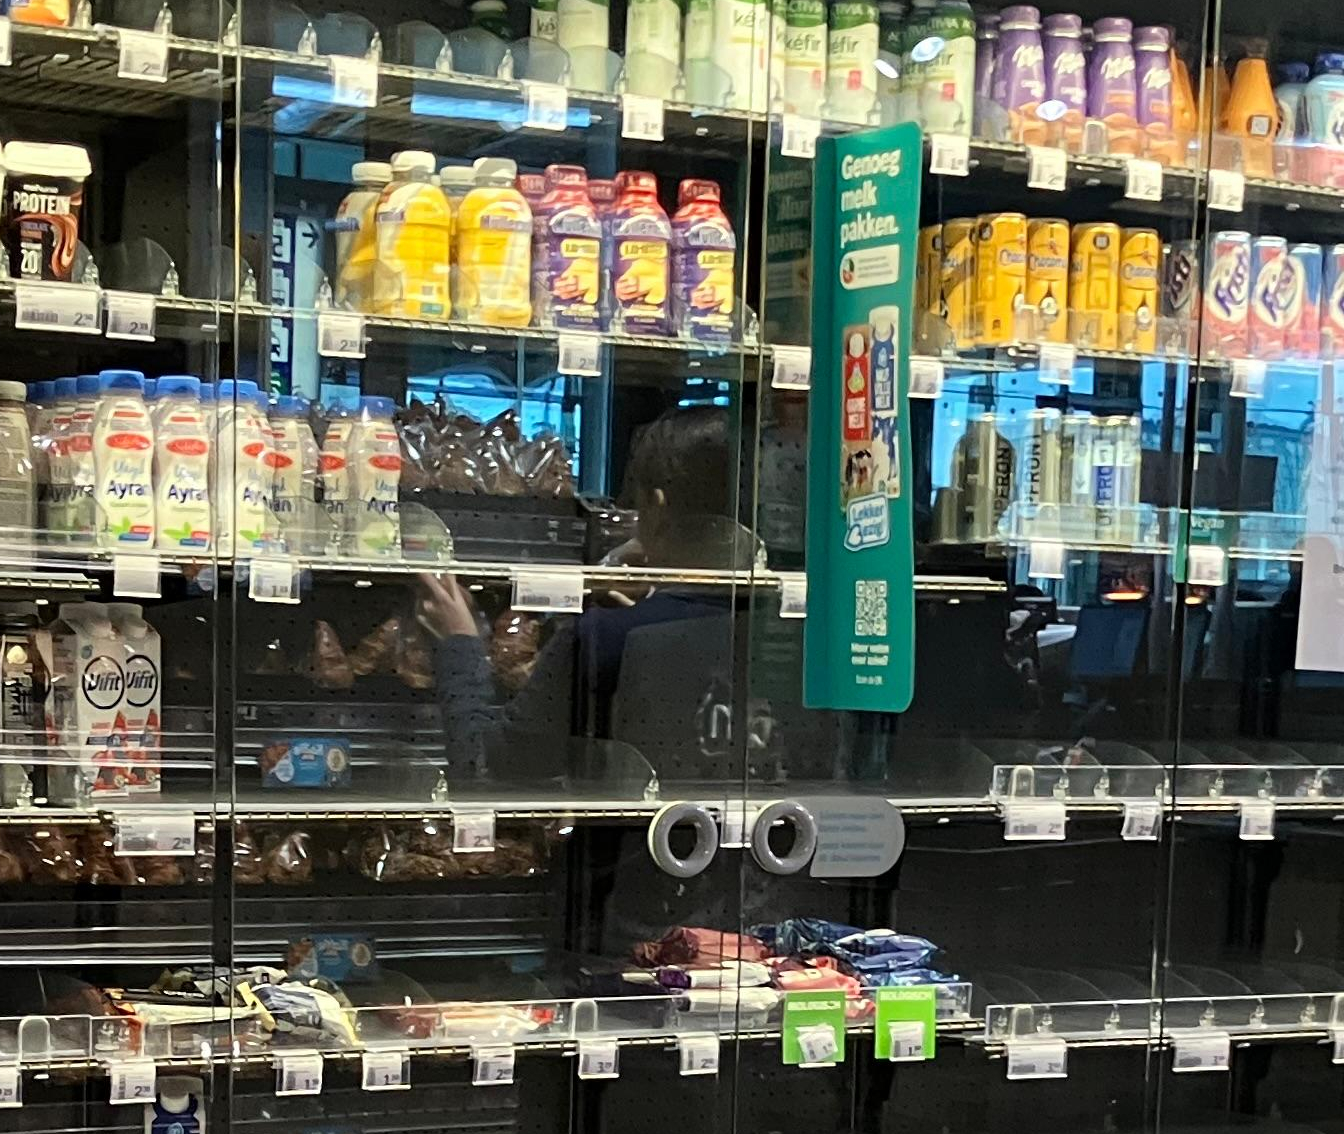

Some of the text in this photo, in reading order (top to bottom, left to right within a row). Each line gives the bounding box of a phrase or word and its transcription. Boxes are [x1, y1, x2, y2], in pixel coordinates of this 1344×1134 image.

[841, 149, 901, 180] Genoeg
[841, 180, 877, 211] melk
[840, 212, 899, 248] pakken.
